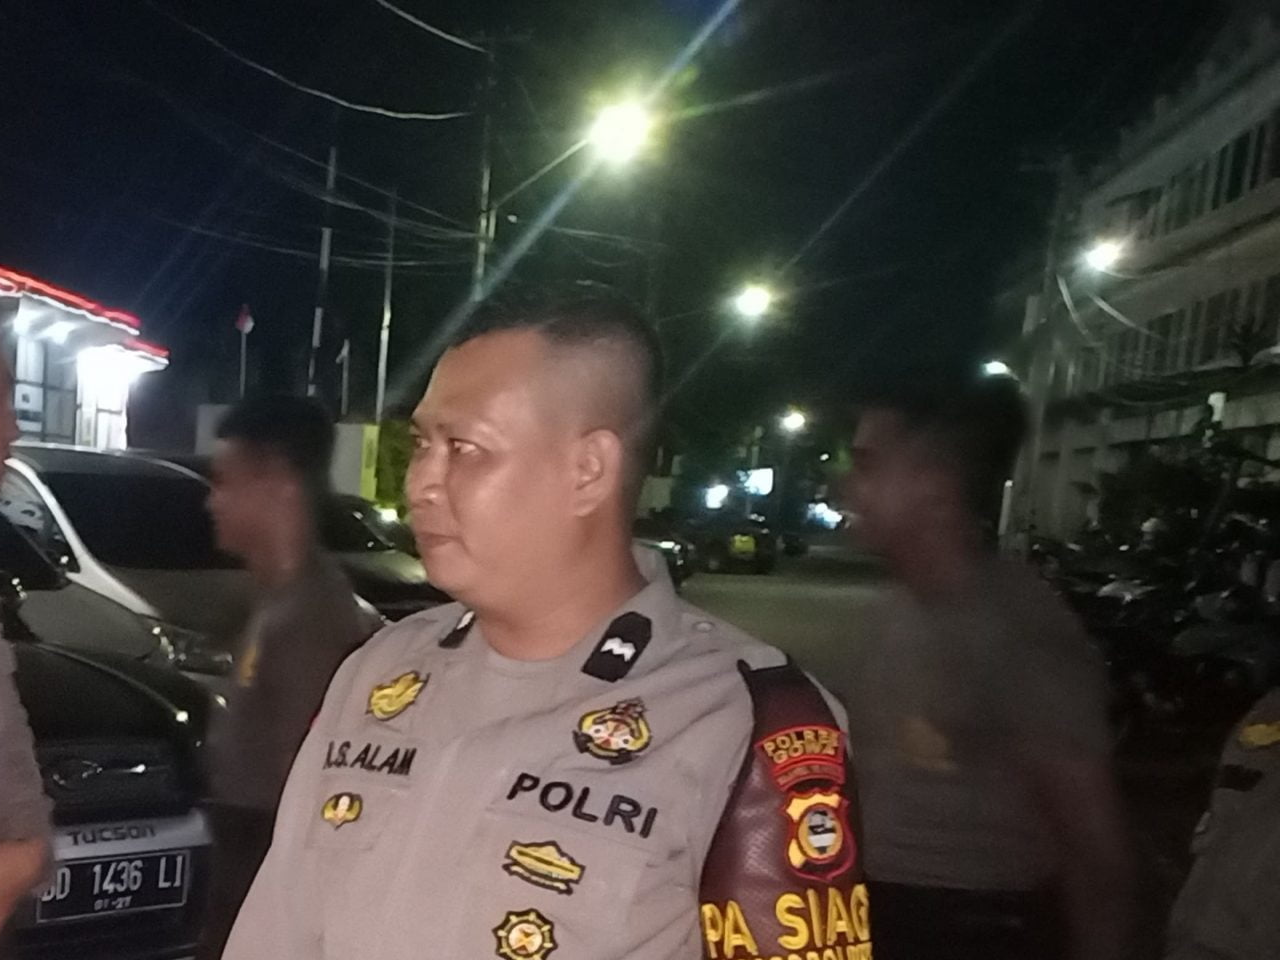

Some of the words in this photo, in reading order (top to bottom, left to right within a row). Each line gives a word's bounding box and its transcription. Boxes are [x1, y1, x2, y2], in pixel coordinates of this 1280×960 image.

[506, 772, 658, 838] POLRI
[93, 859, 143, 895] 1436
[701, 900, 759, 959] PA
